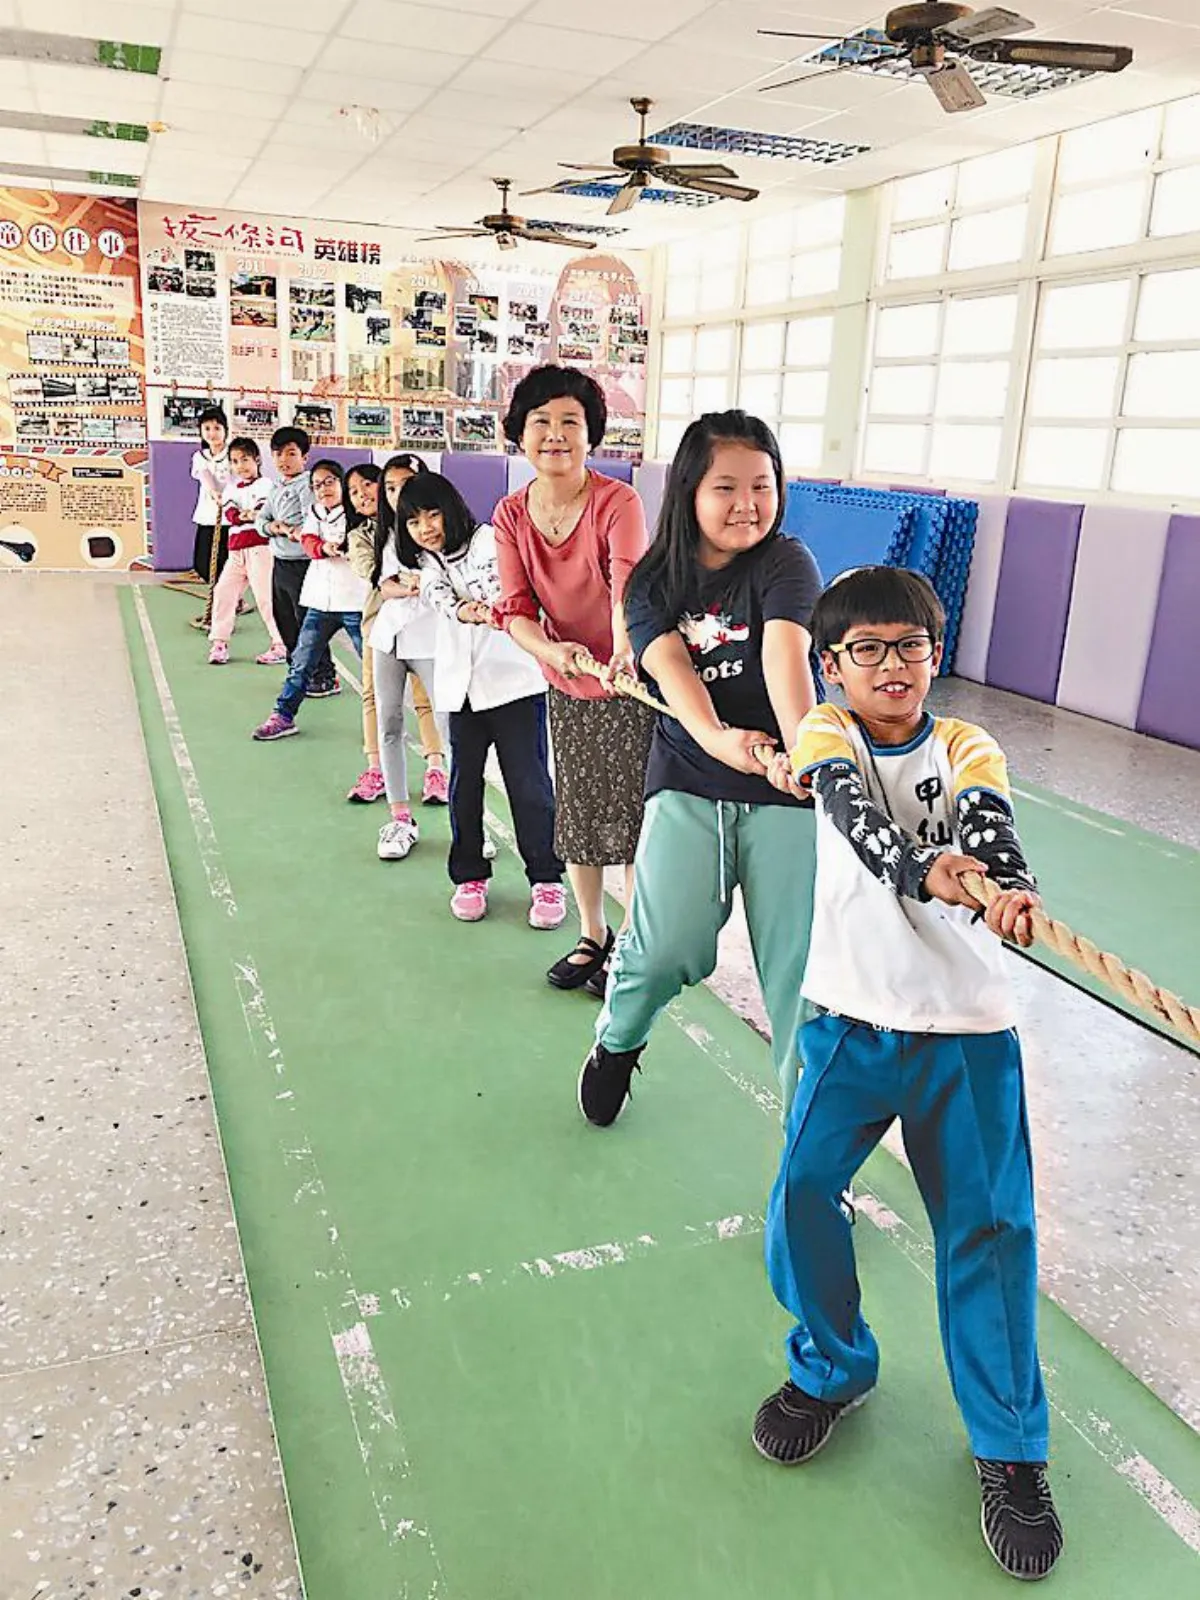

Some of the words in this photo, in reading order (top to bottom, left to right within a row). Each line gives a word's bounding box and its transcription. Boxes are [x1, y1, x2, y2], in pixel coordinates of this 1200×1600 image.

[314, 236, 381, 265] 英雄榜
[236, 258, 266, 273] 2011
[694, 659, 743, 682] ots
[915, 777, 953, 846] 甲仙
